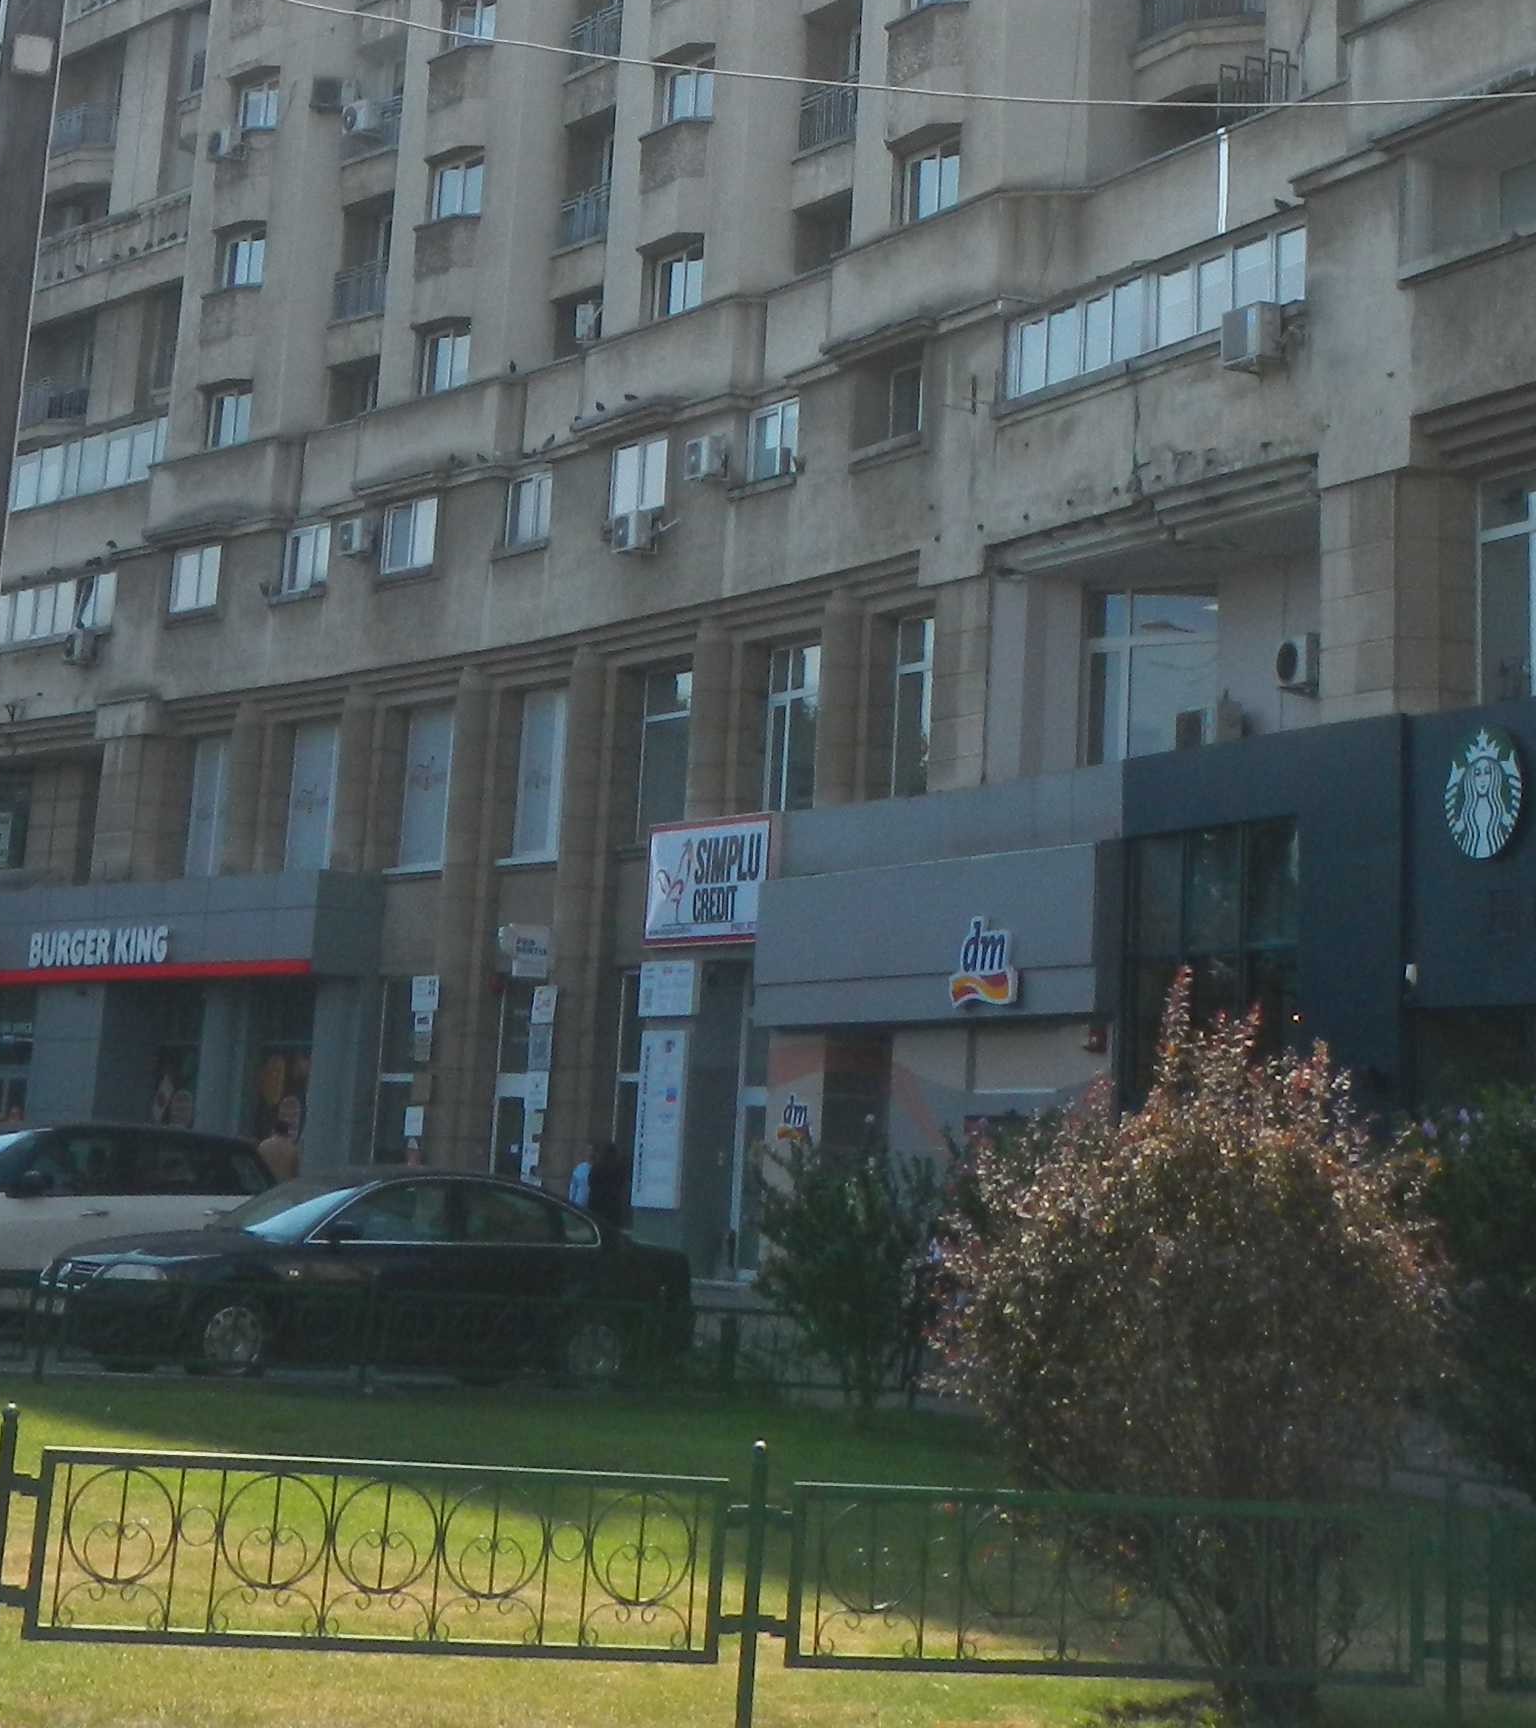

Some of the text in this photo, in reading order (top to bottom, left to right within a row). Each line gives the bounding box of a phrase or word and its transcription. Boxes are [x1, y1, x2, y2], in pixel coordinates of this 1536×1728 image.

[694, 833, 762, 885] SIMPLU
[692, 885, 738, 922] CREDIT
[28, 925, 169, 968] BURGER KING
[963, 920, 1006, 972] dm
[783, 1094, 809, 1128] dm
